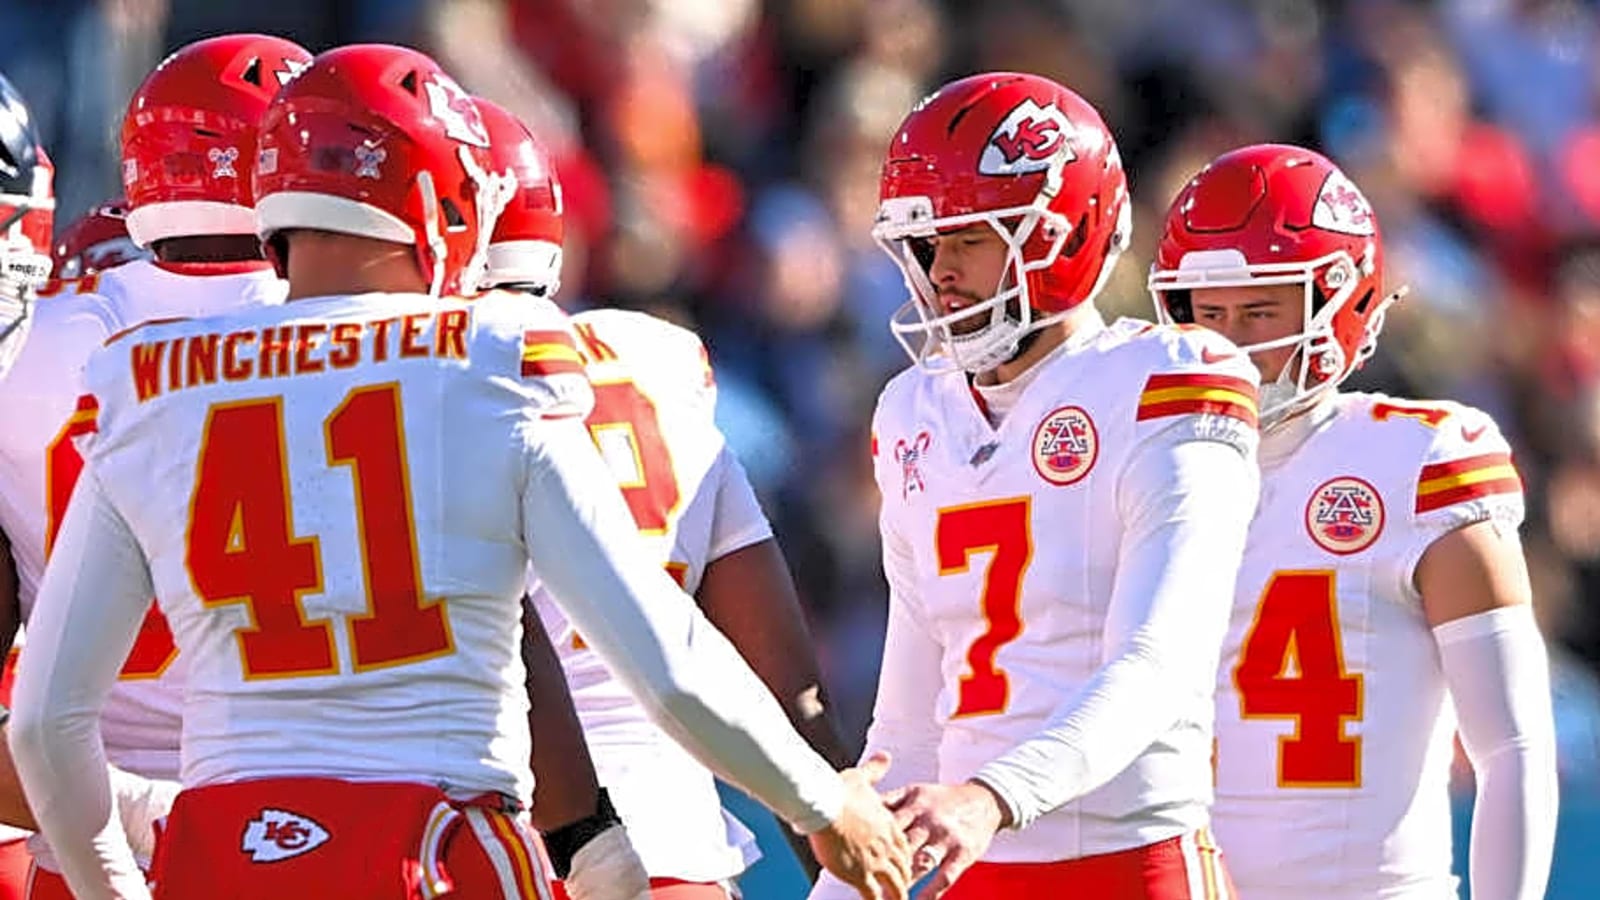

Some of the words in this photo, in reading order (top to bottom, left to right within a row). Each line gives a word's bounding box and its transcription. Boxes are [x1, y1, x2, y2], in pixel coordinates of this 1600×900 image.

[992, 116, 1065, 164] KC
[130, 309, 470, 403] WINCHESTER
[1040, 416, 1089, 456] A
[184, 381, 457, 682] 41
[1316, 486, 1373, 525] A
[934, 494, 1035, 720] 7
[1210, 569, 1364, 789] 4
[263, 821, 311, 850] KC
